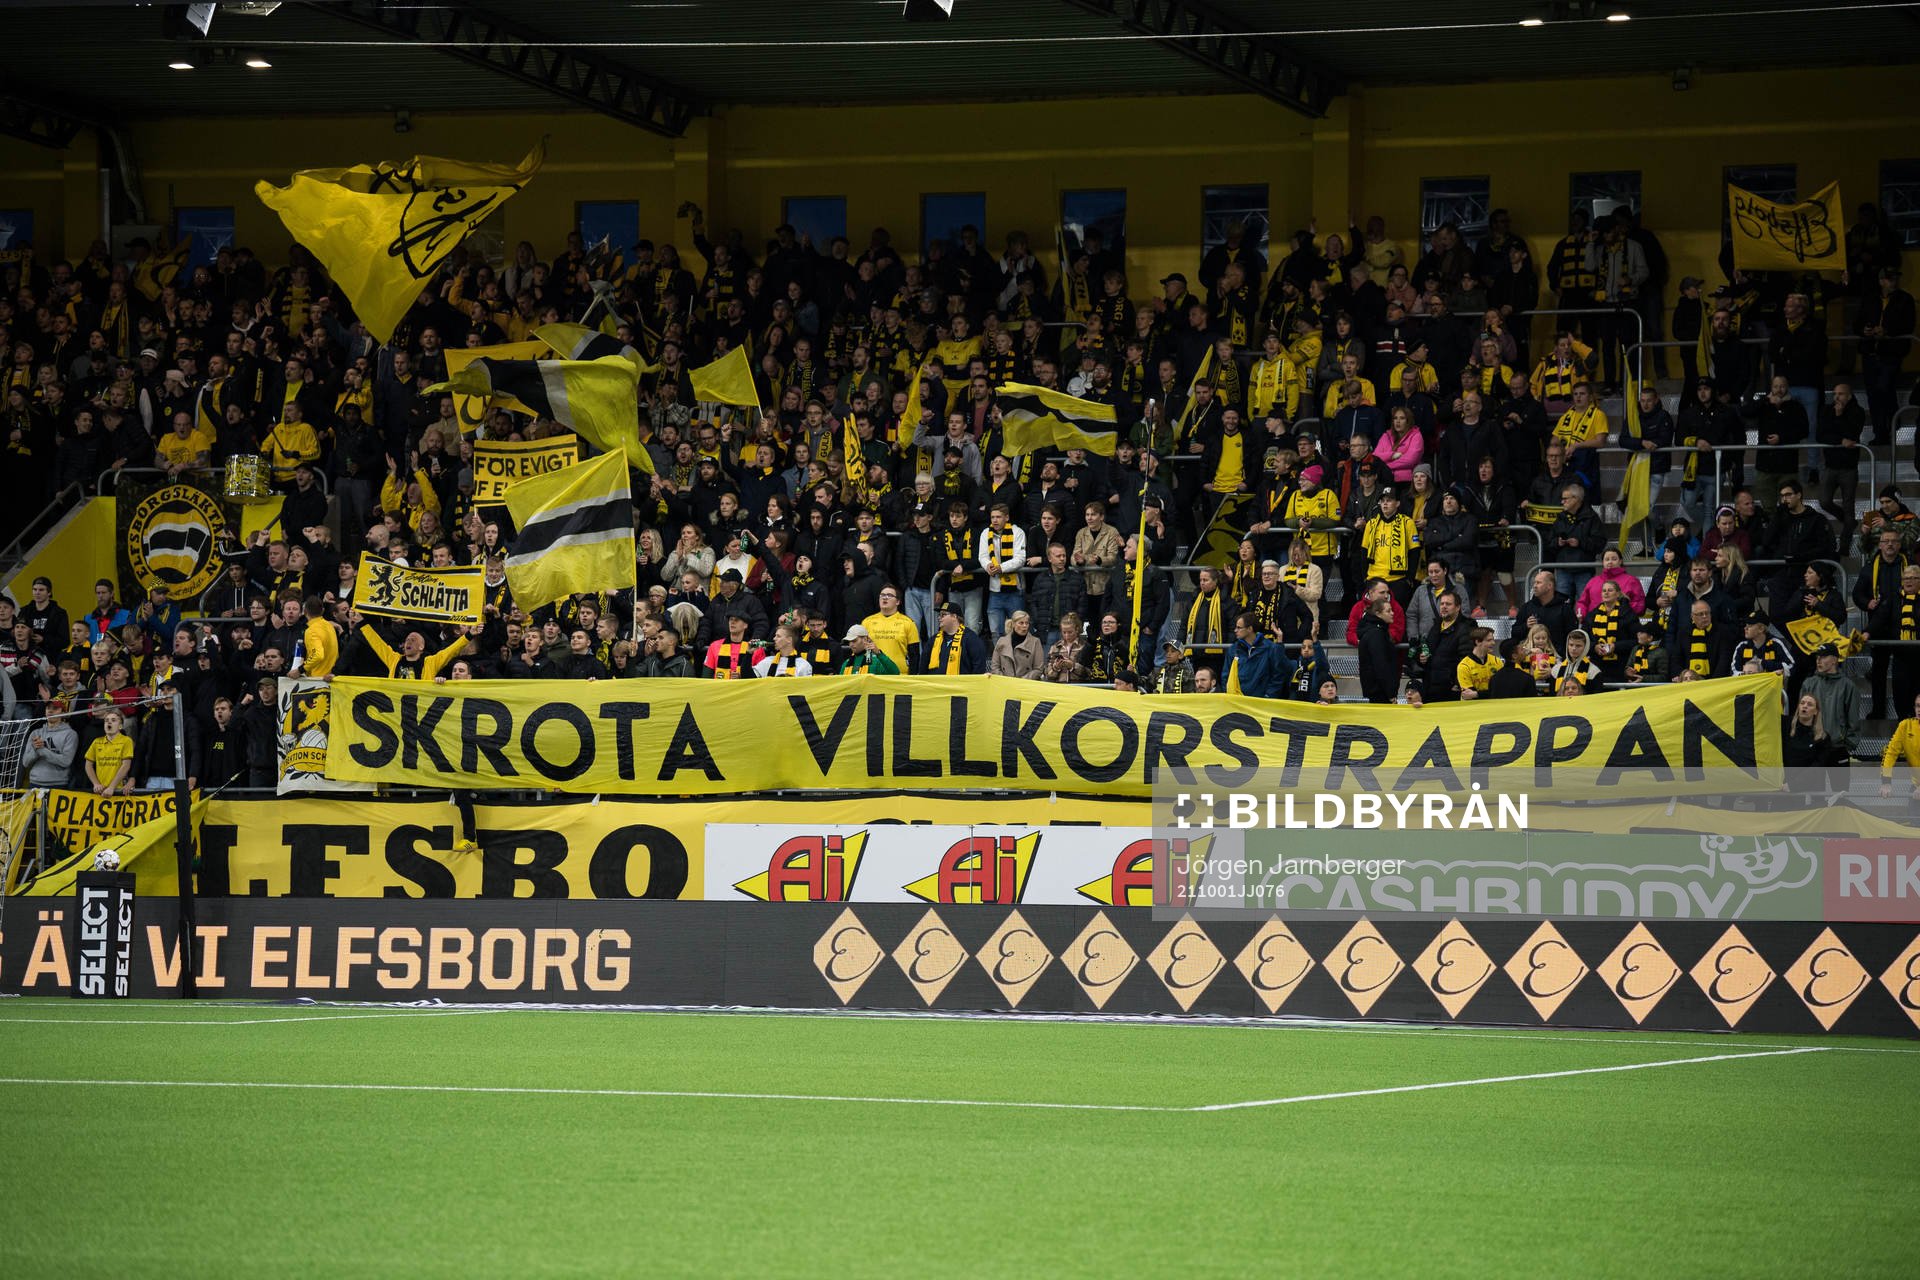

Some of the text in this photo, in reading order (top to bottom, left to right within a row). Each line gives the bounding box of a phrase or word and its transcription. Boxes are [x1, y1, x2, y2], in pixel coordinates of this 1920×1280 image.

[475, 452, 574, 477] FÖR EVIGT
[130, 487, 224, 579] ELFSBORGSLÄKTAEN
[401, 582, 468, 612] SCHLÄTTA
[311, 752, 327, 760] SCH
[349, 690, 1760, 791] SKROTA VILLKORSTRAPPAN
[1274, 874, 1736, 918] CASHBUDDY
[22, 910, 631, 991] Ä VI ELFSBORG
[79, 887, 109, 995] SELECT
[115, 888, 133, 996] SELECT
